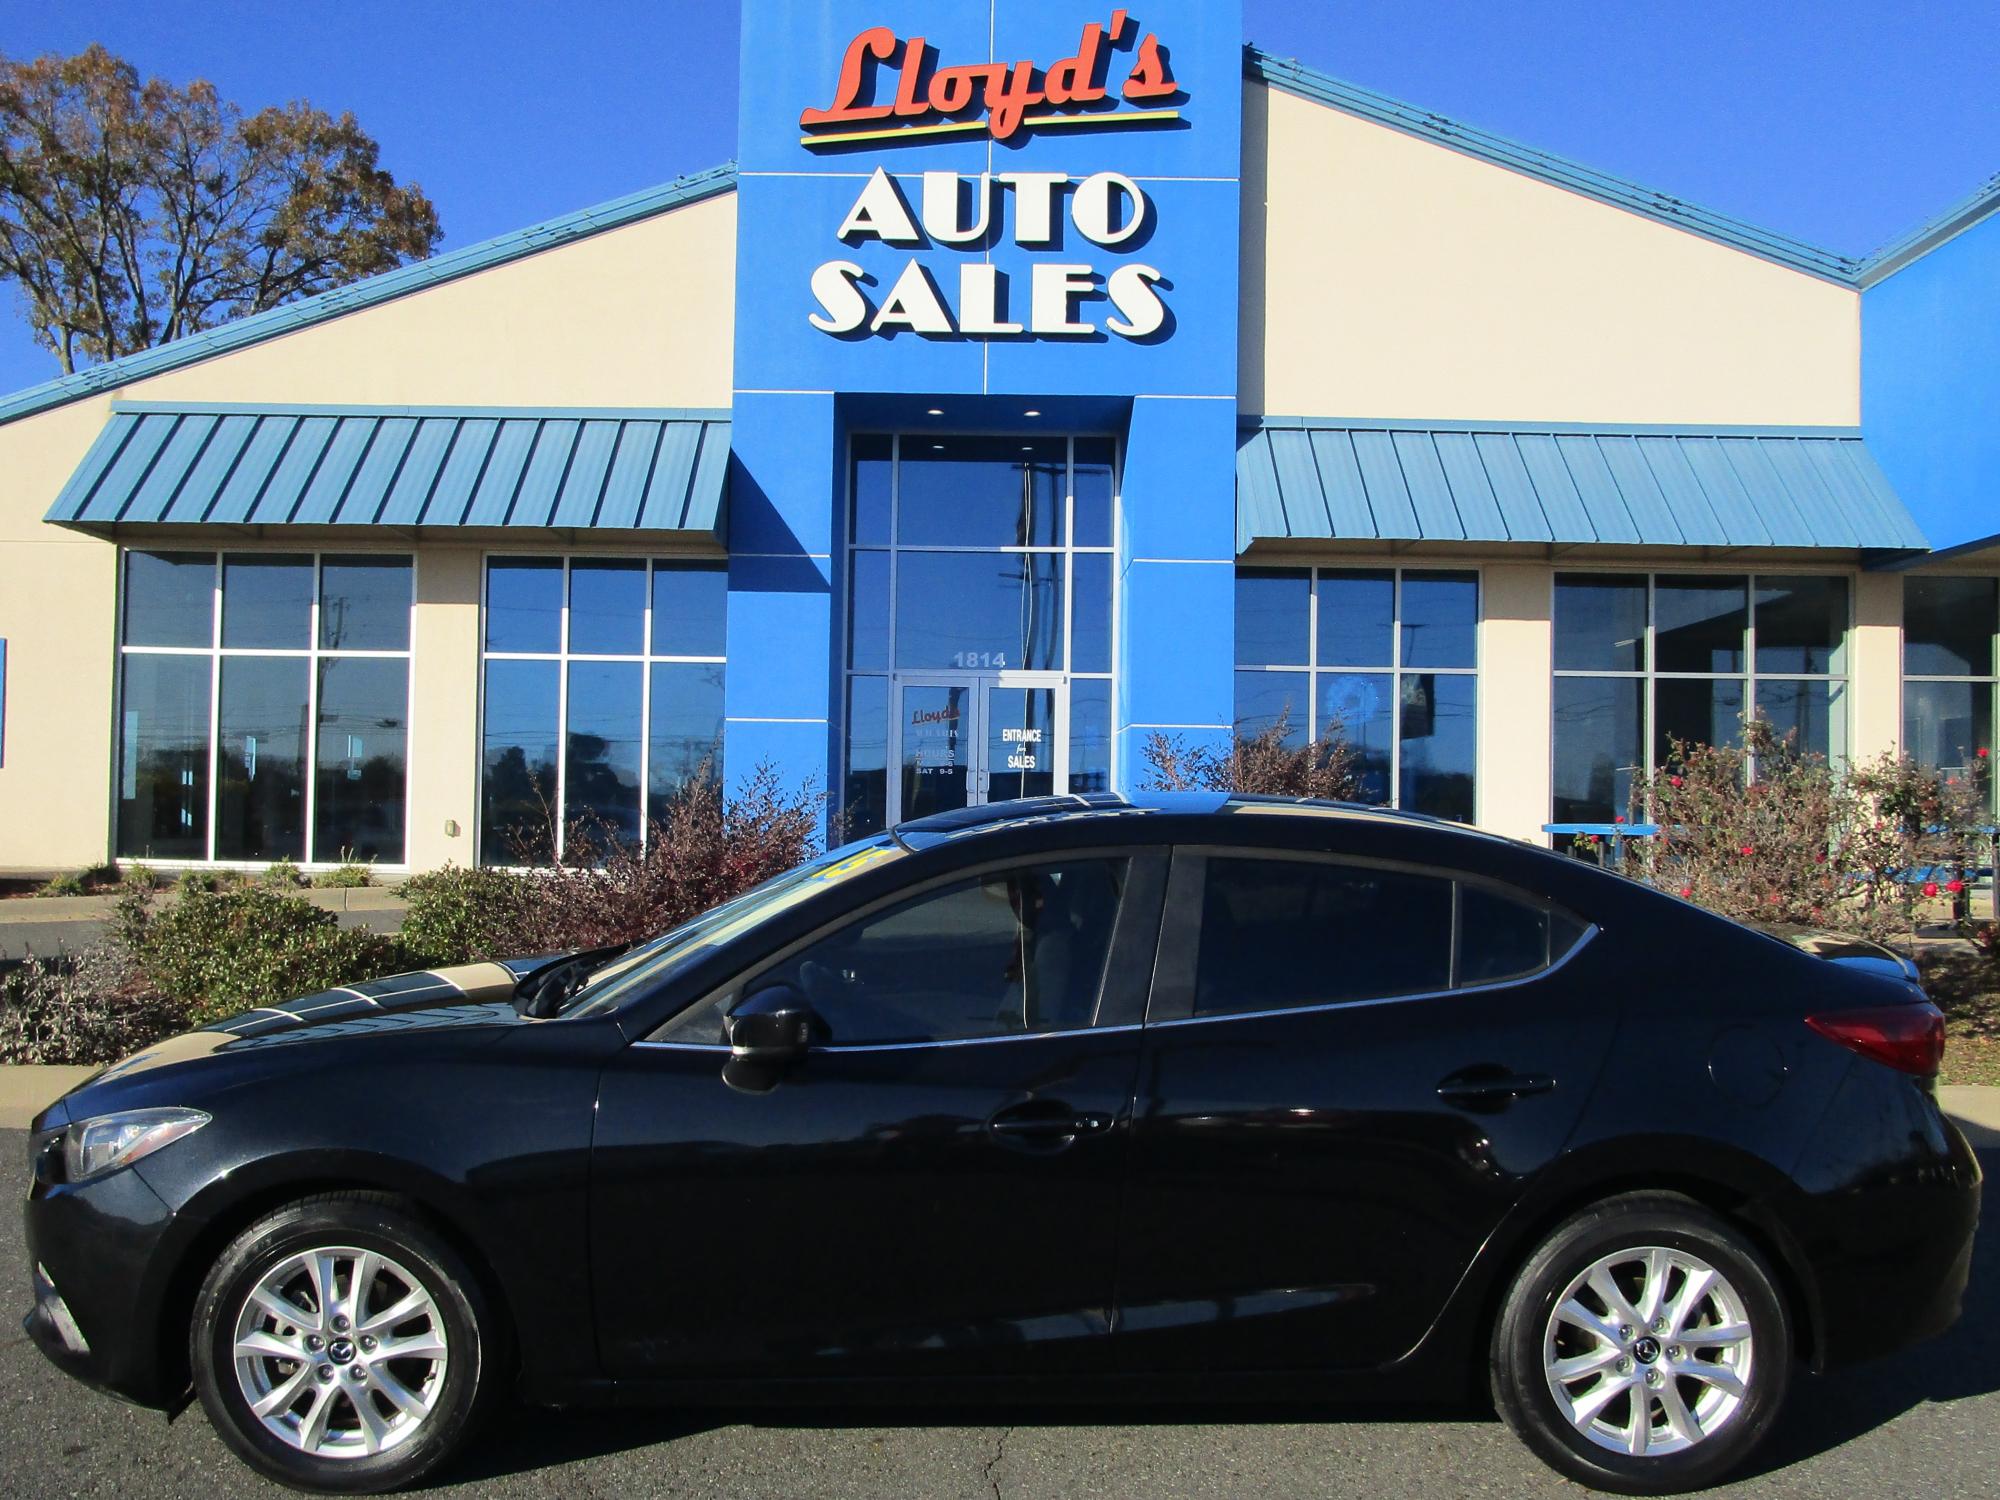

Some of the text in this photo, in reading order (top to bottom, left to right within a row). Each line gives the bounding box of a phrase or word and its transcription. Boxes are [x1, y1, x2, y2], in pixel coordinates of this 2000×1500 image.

[800, 9, 1178, 139] Lloyd's
[837, 166, 1144, 244] AUTO
[809, 258, 1165, 336] SALES
[954, 653, 1005, 668] 1814
[912, 706, 960, 725] Lloyd
[1002, 729, 1042, 742] ENTRANCE
[1007, 755, 1036, 768] SALES
